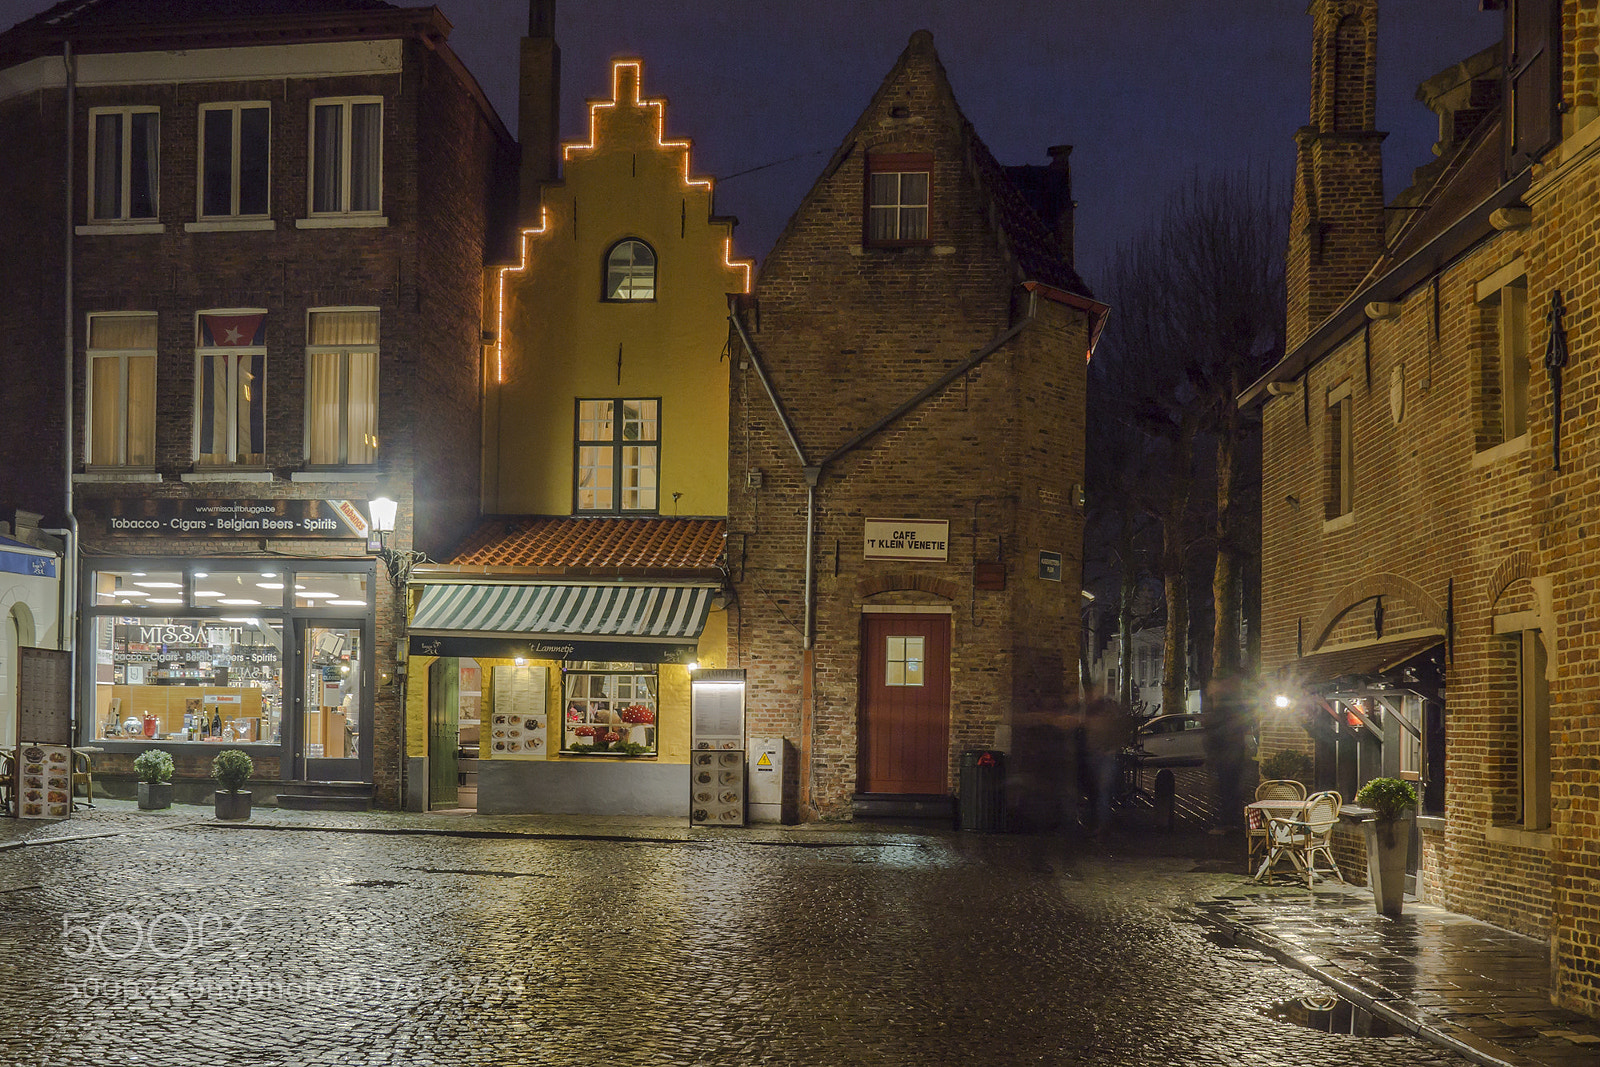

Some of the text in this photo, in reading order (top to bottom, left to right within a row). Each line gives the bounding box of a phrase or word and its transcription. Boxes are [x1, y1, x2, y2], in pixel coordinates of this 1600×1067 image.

[340, 502, 366, 531] Habanos
[111, 518, 160, 529] Tobacco
[170, 518, 207, 531] Cigars
[217, 518, 259, 531] Belgian
[262, 518, 294, 530] Beers
[303, 518, 338, 531] Spirits
[893, 530, 917, 540] CAFE
[878, 539, 905, 549] KLEIN
[907, 540, 946, 550] VENETIE
[535, 642, 576, 660] Lammetje
[251, 653, 278, 664] Spirits
